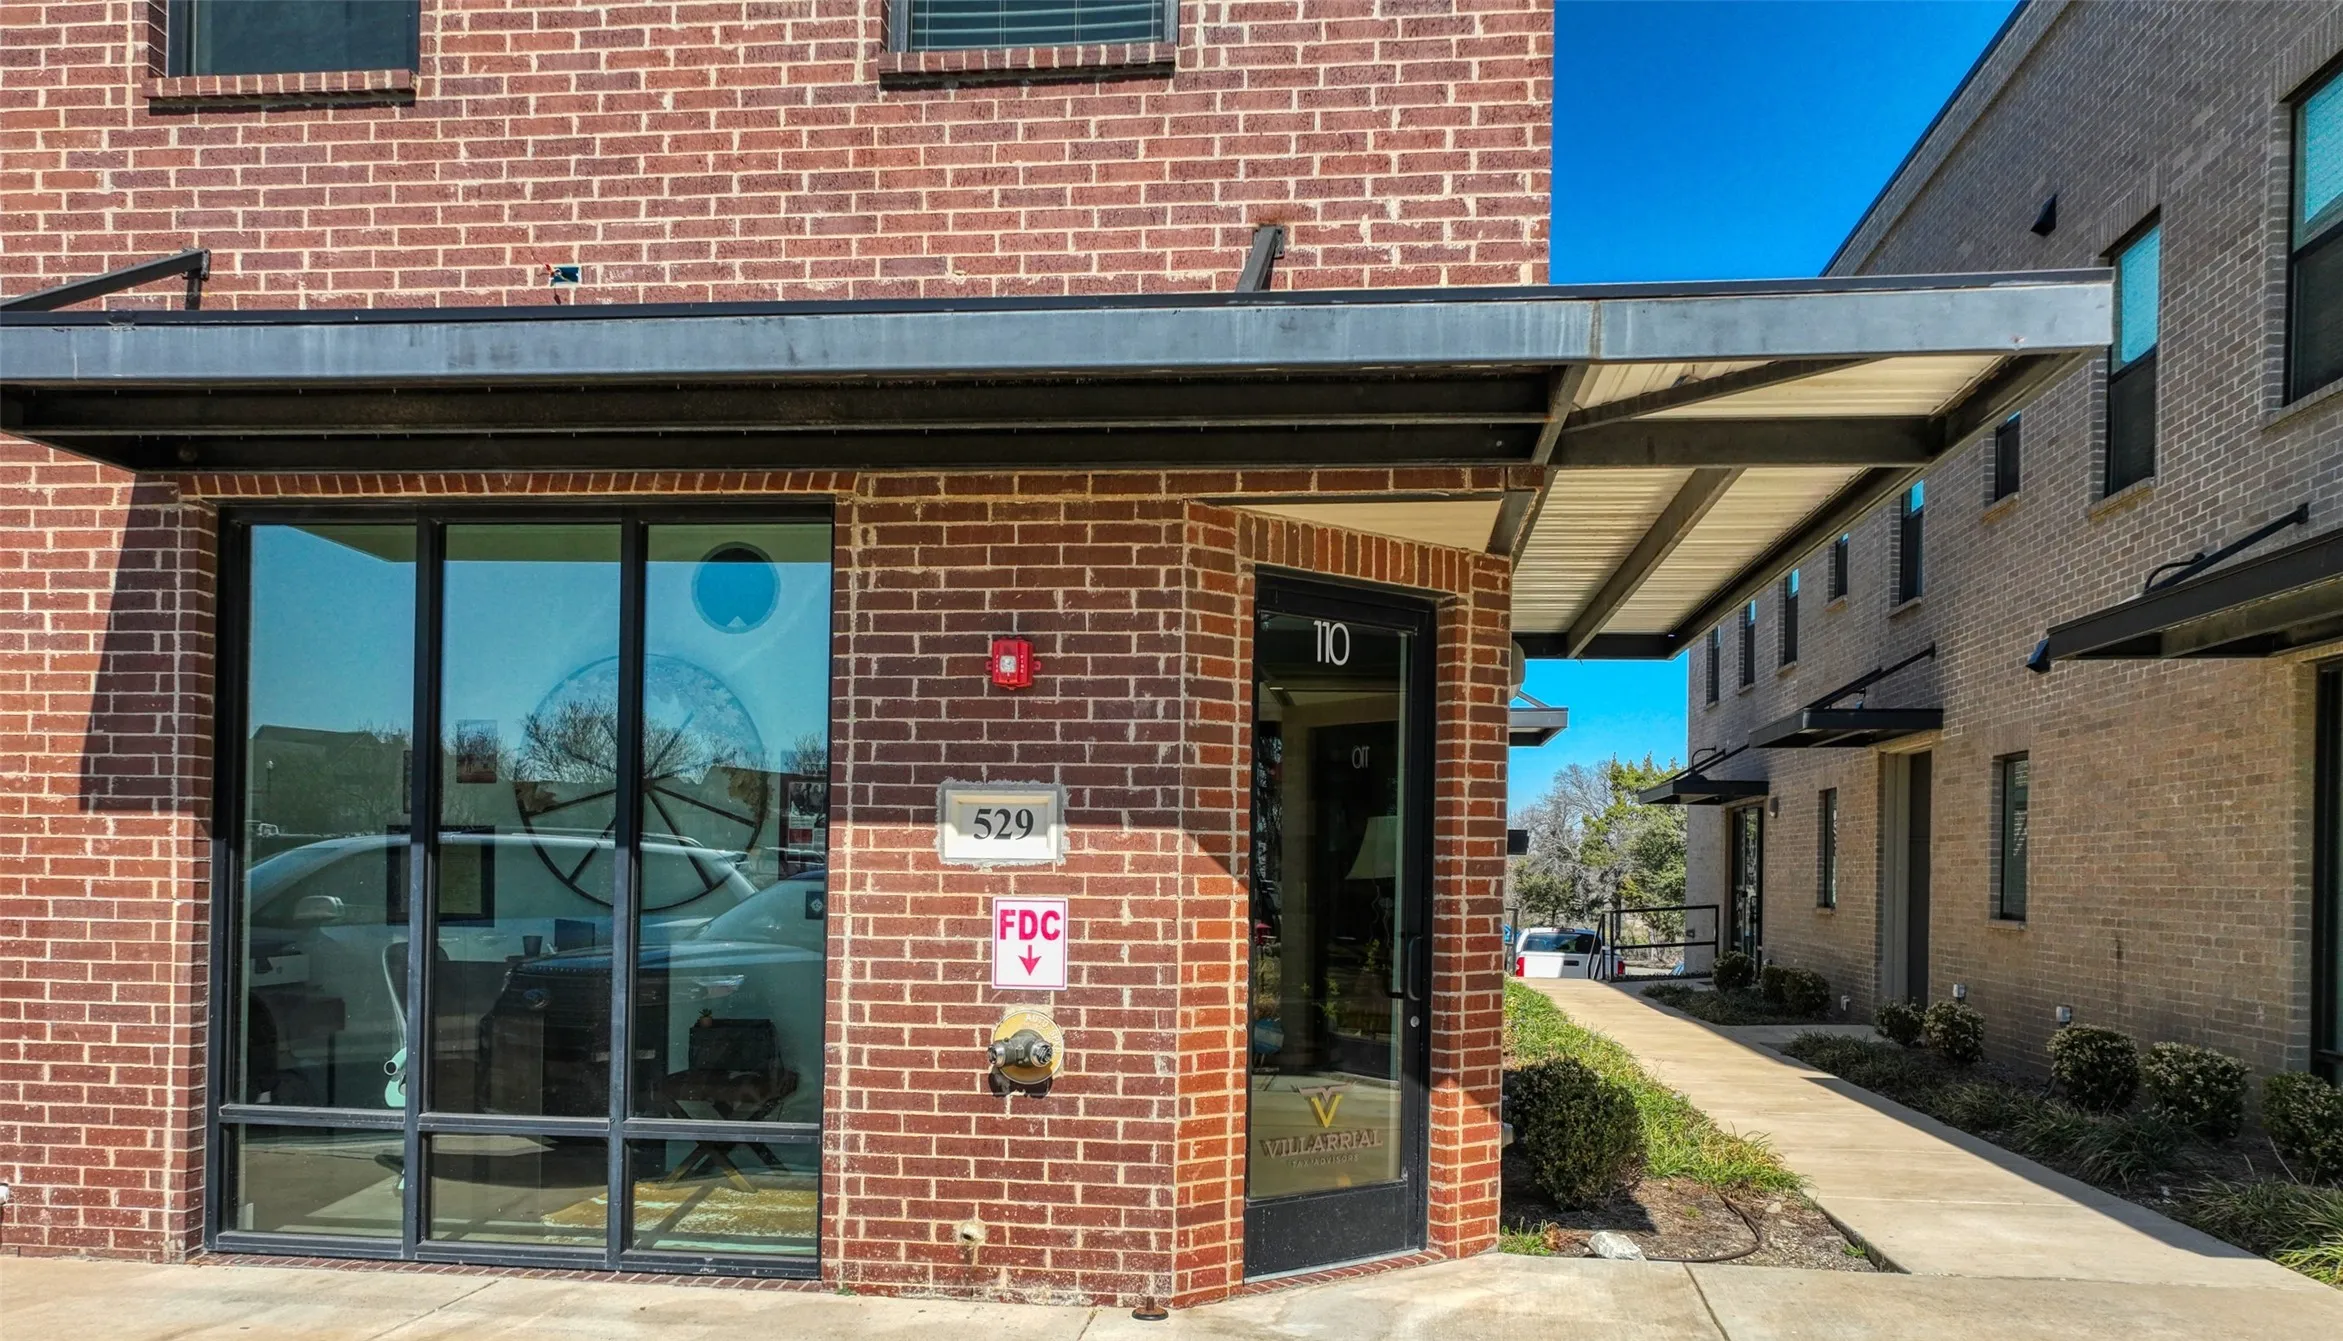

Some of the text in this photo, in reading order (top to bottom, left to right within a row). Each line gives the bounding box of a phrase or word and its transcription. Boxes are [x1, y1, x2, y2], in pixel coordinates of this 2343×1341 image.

[1313, 620, 1350, 666] 110
[973, 808, 1034, 840] 529
[1000, 909, 1061, 941] FDC
[1264, 1129, 1384, 1159] VILLARRIAL
[1292, 1153, 1360, 1169] TAX ADVISORS
